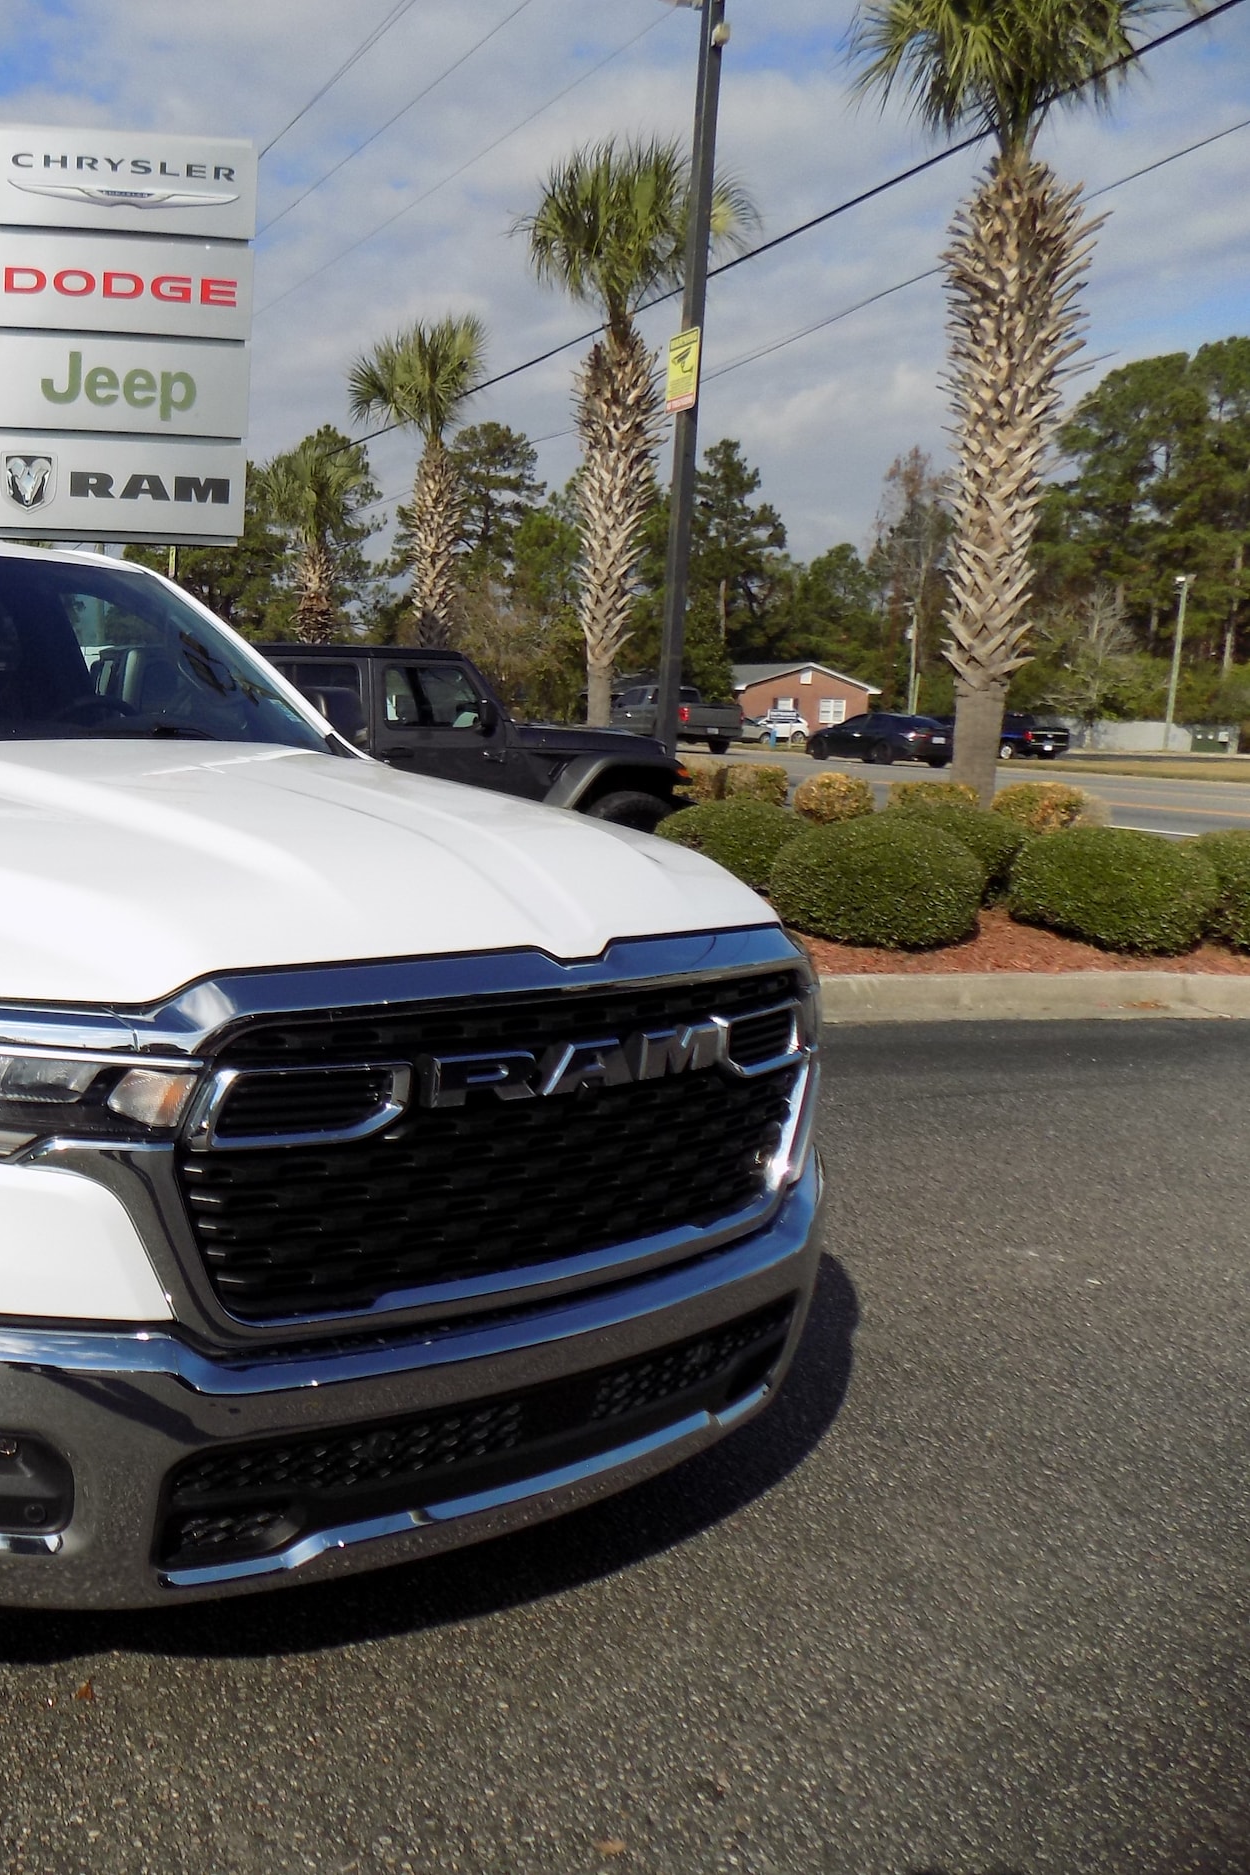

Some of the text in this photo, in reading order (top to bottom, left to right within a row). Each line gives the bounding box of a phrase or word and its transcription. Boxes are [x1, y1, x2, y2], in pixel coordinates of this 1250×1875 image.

[11, 152, 236, 183] CHRYSLER
[3, 266, 237, 307] DODGE
[40, 351, 197, 421] Jeep
[69, 471, 230, 505] RAM
[423, 1021, 720, 1109] RAM
